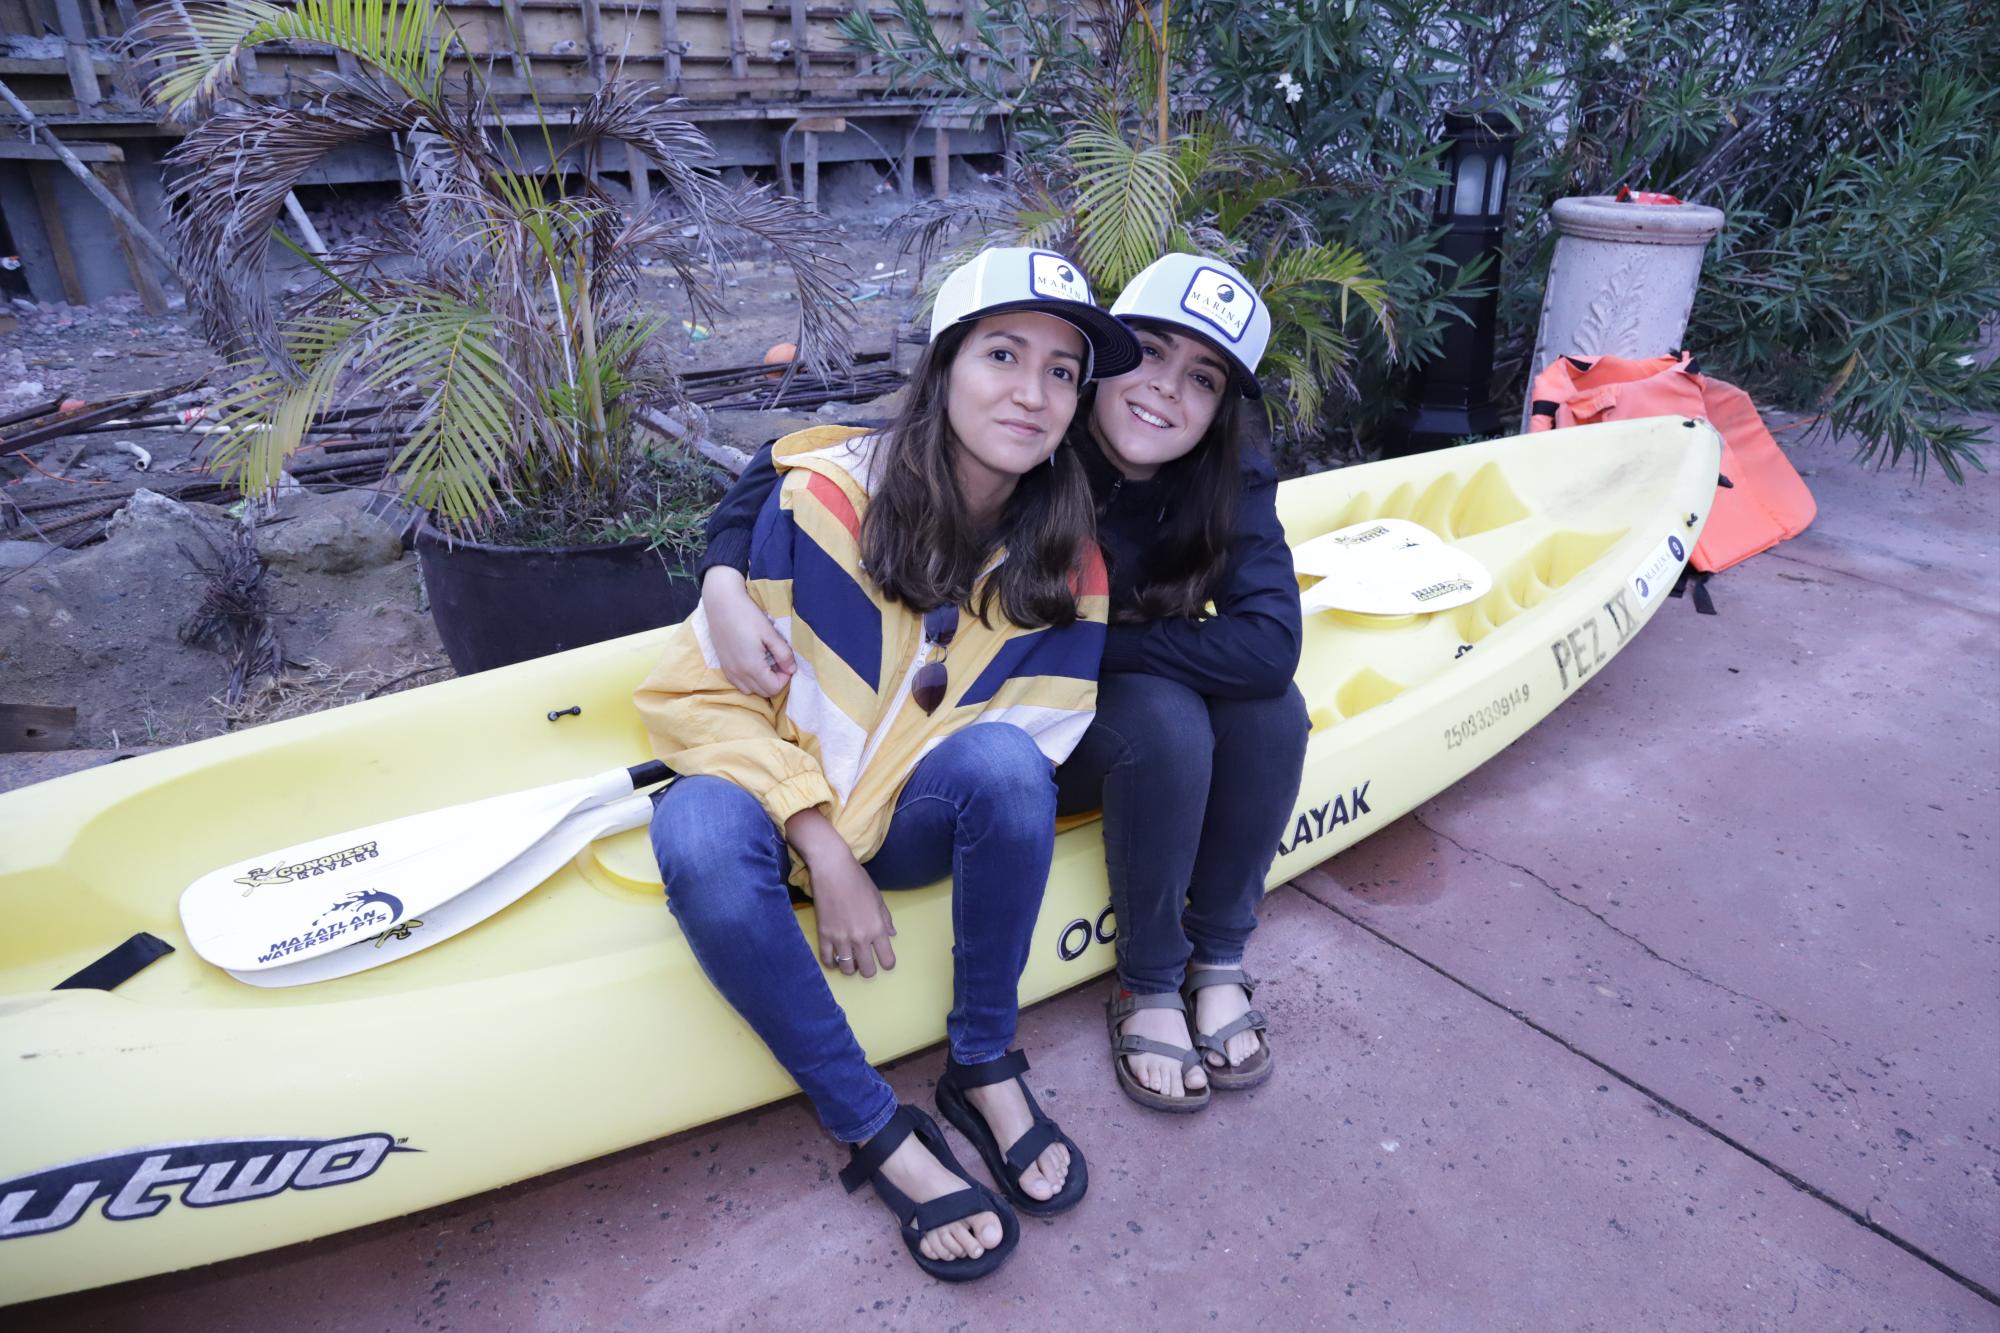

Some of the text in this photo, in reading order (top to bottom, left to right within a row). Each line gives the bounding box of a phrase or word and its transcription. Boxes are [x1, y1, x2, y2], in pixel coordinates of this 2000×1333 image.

[1192, 291, 1241, 328] MARINA
[1550, 617, 1607, 690] PEZ
[277, 841, 377, 878] CONQUEST
[297, 850, 379, 880] KAYAKS
[270, 910, 375, 952] MAZATLAN
